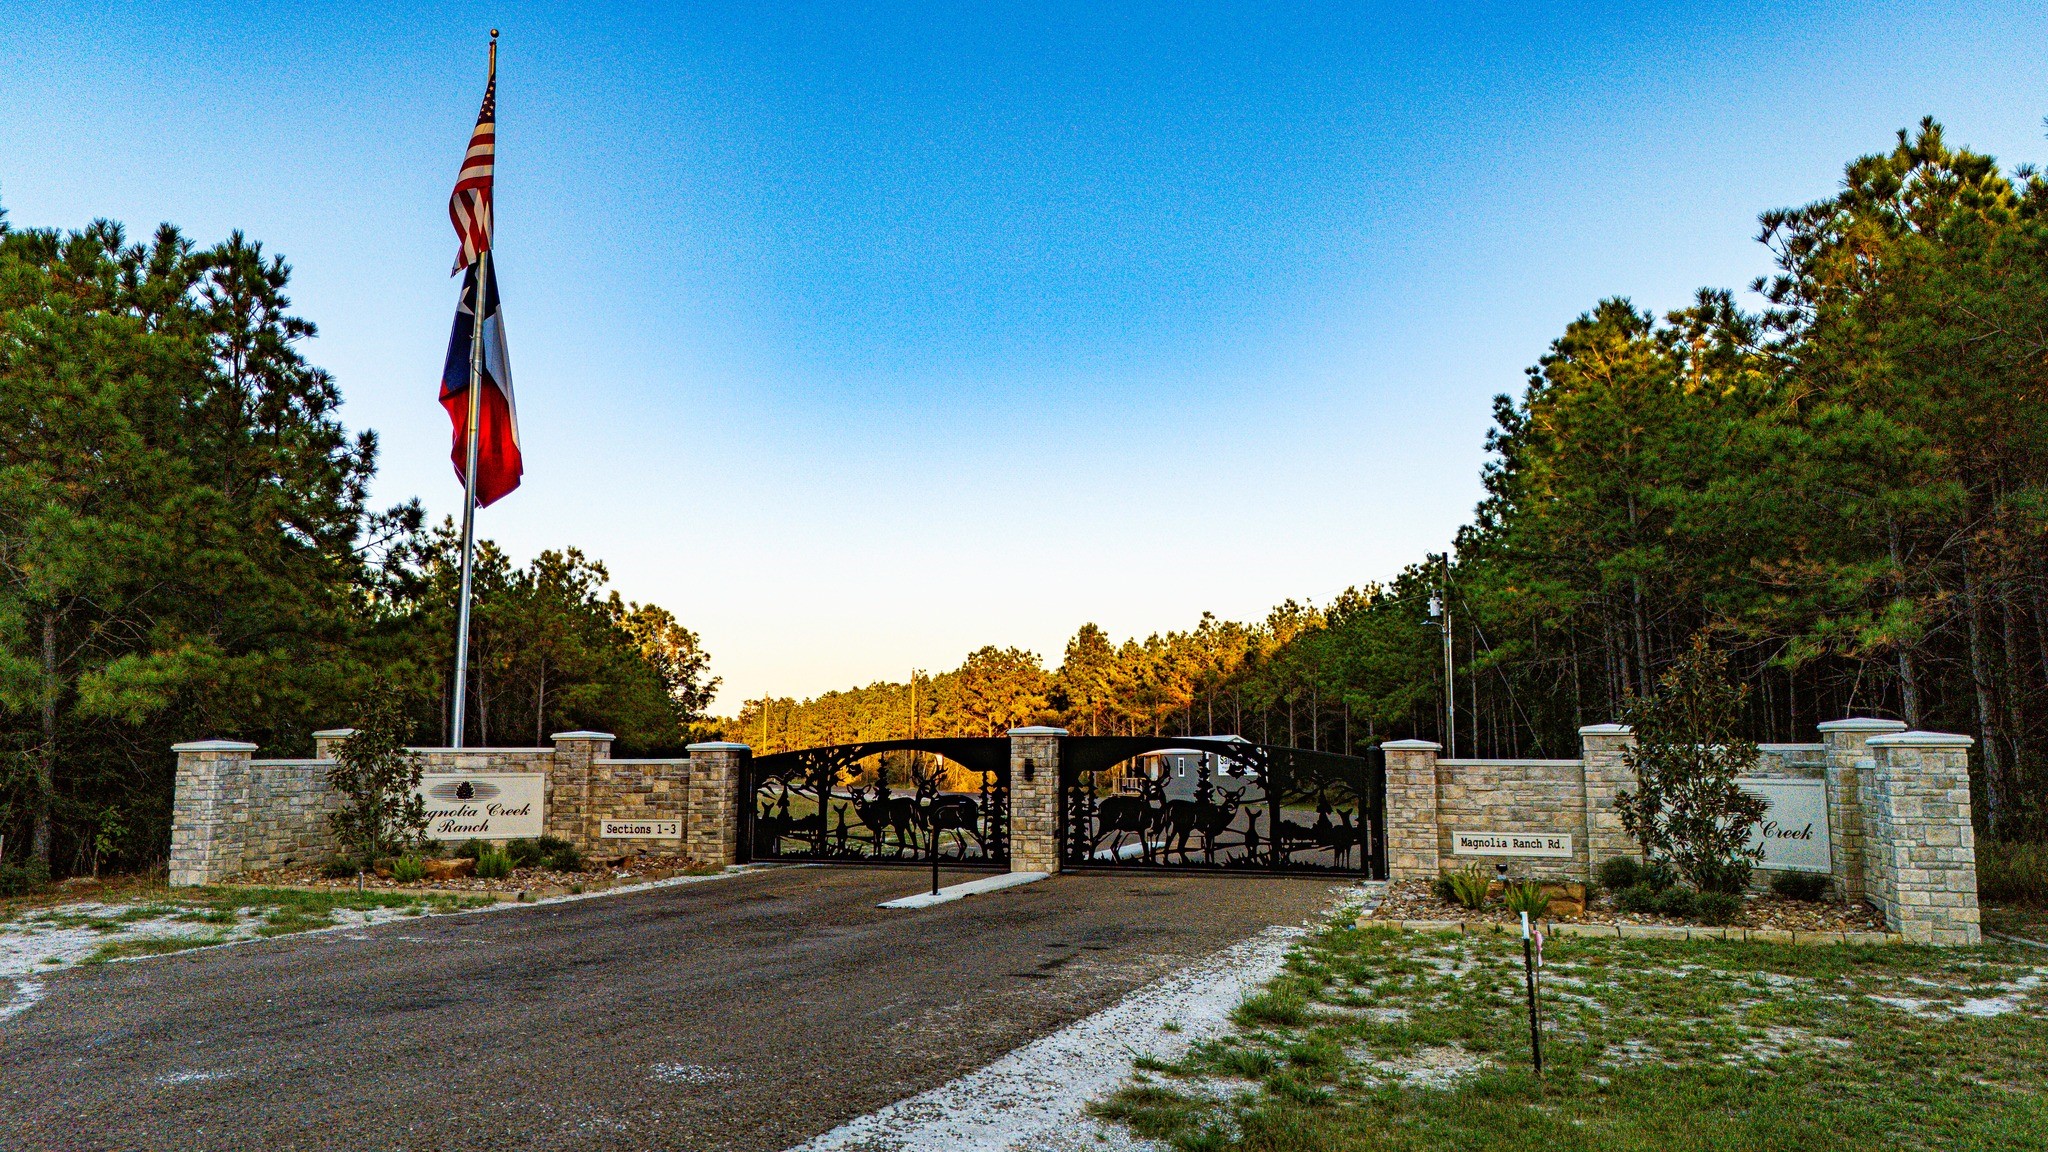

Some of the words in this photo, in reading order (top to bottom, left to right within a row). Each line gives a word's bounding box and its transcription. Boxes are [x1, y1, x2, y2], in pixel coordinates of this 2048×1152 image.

[419, 804, 478, 823] agnolia
[486, 803, 531, 817] Creek
[437, 819, 489, 833] Ranch
[606, 823, 652, 835] Sections
[657, 823, 677, 835] 1-3
[1760, 820, 1813, 840] Creek
[1460, 837, 1508, 850] Magnolia
[1513, 838, 1543, 849] Ranch
[1548, 839, 1565, 850] Rd.
